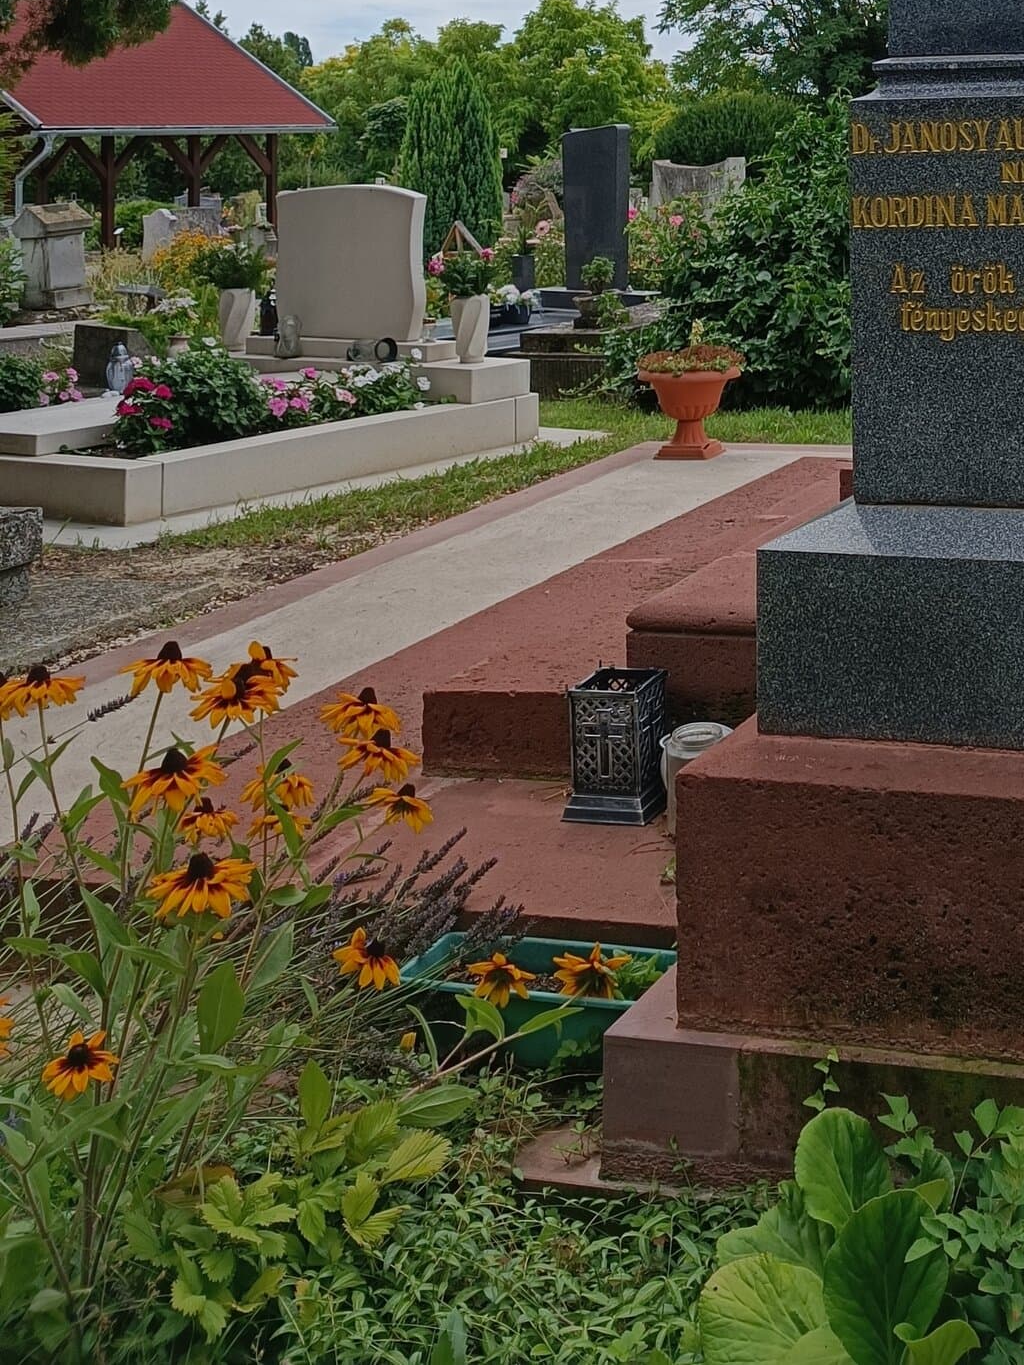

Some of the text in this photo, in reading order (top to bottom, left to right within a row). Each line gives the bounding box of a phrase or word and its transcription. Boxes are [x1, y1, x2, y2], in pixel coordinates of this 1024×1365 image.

[852, 194, 979, 228] KORDINA
[890, 263, 925, 294] Az
[951, 264, 1017, 294] örök
